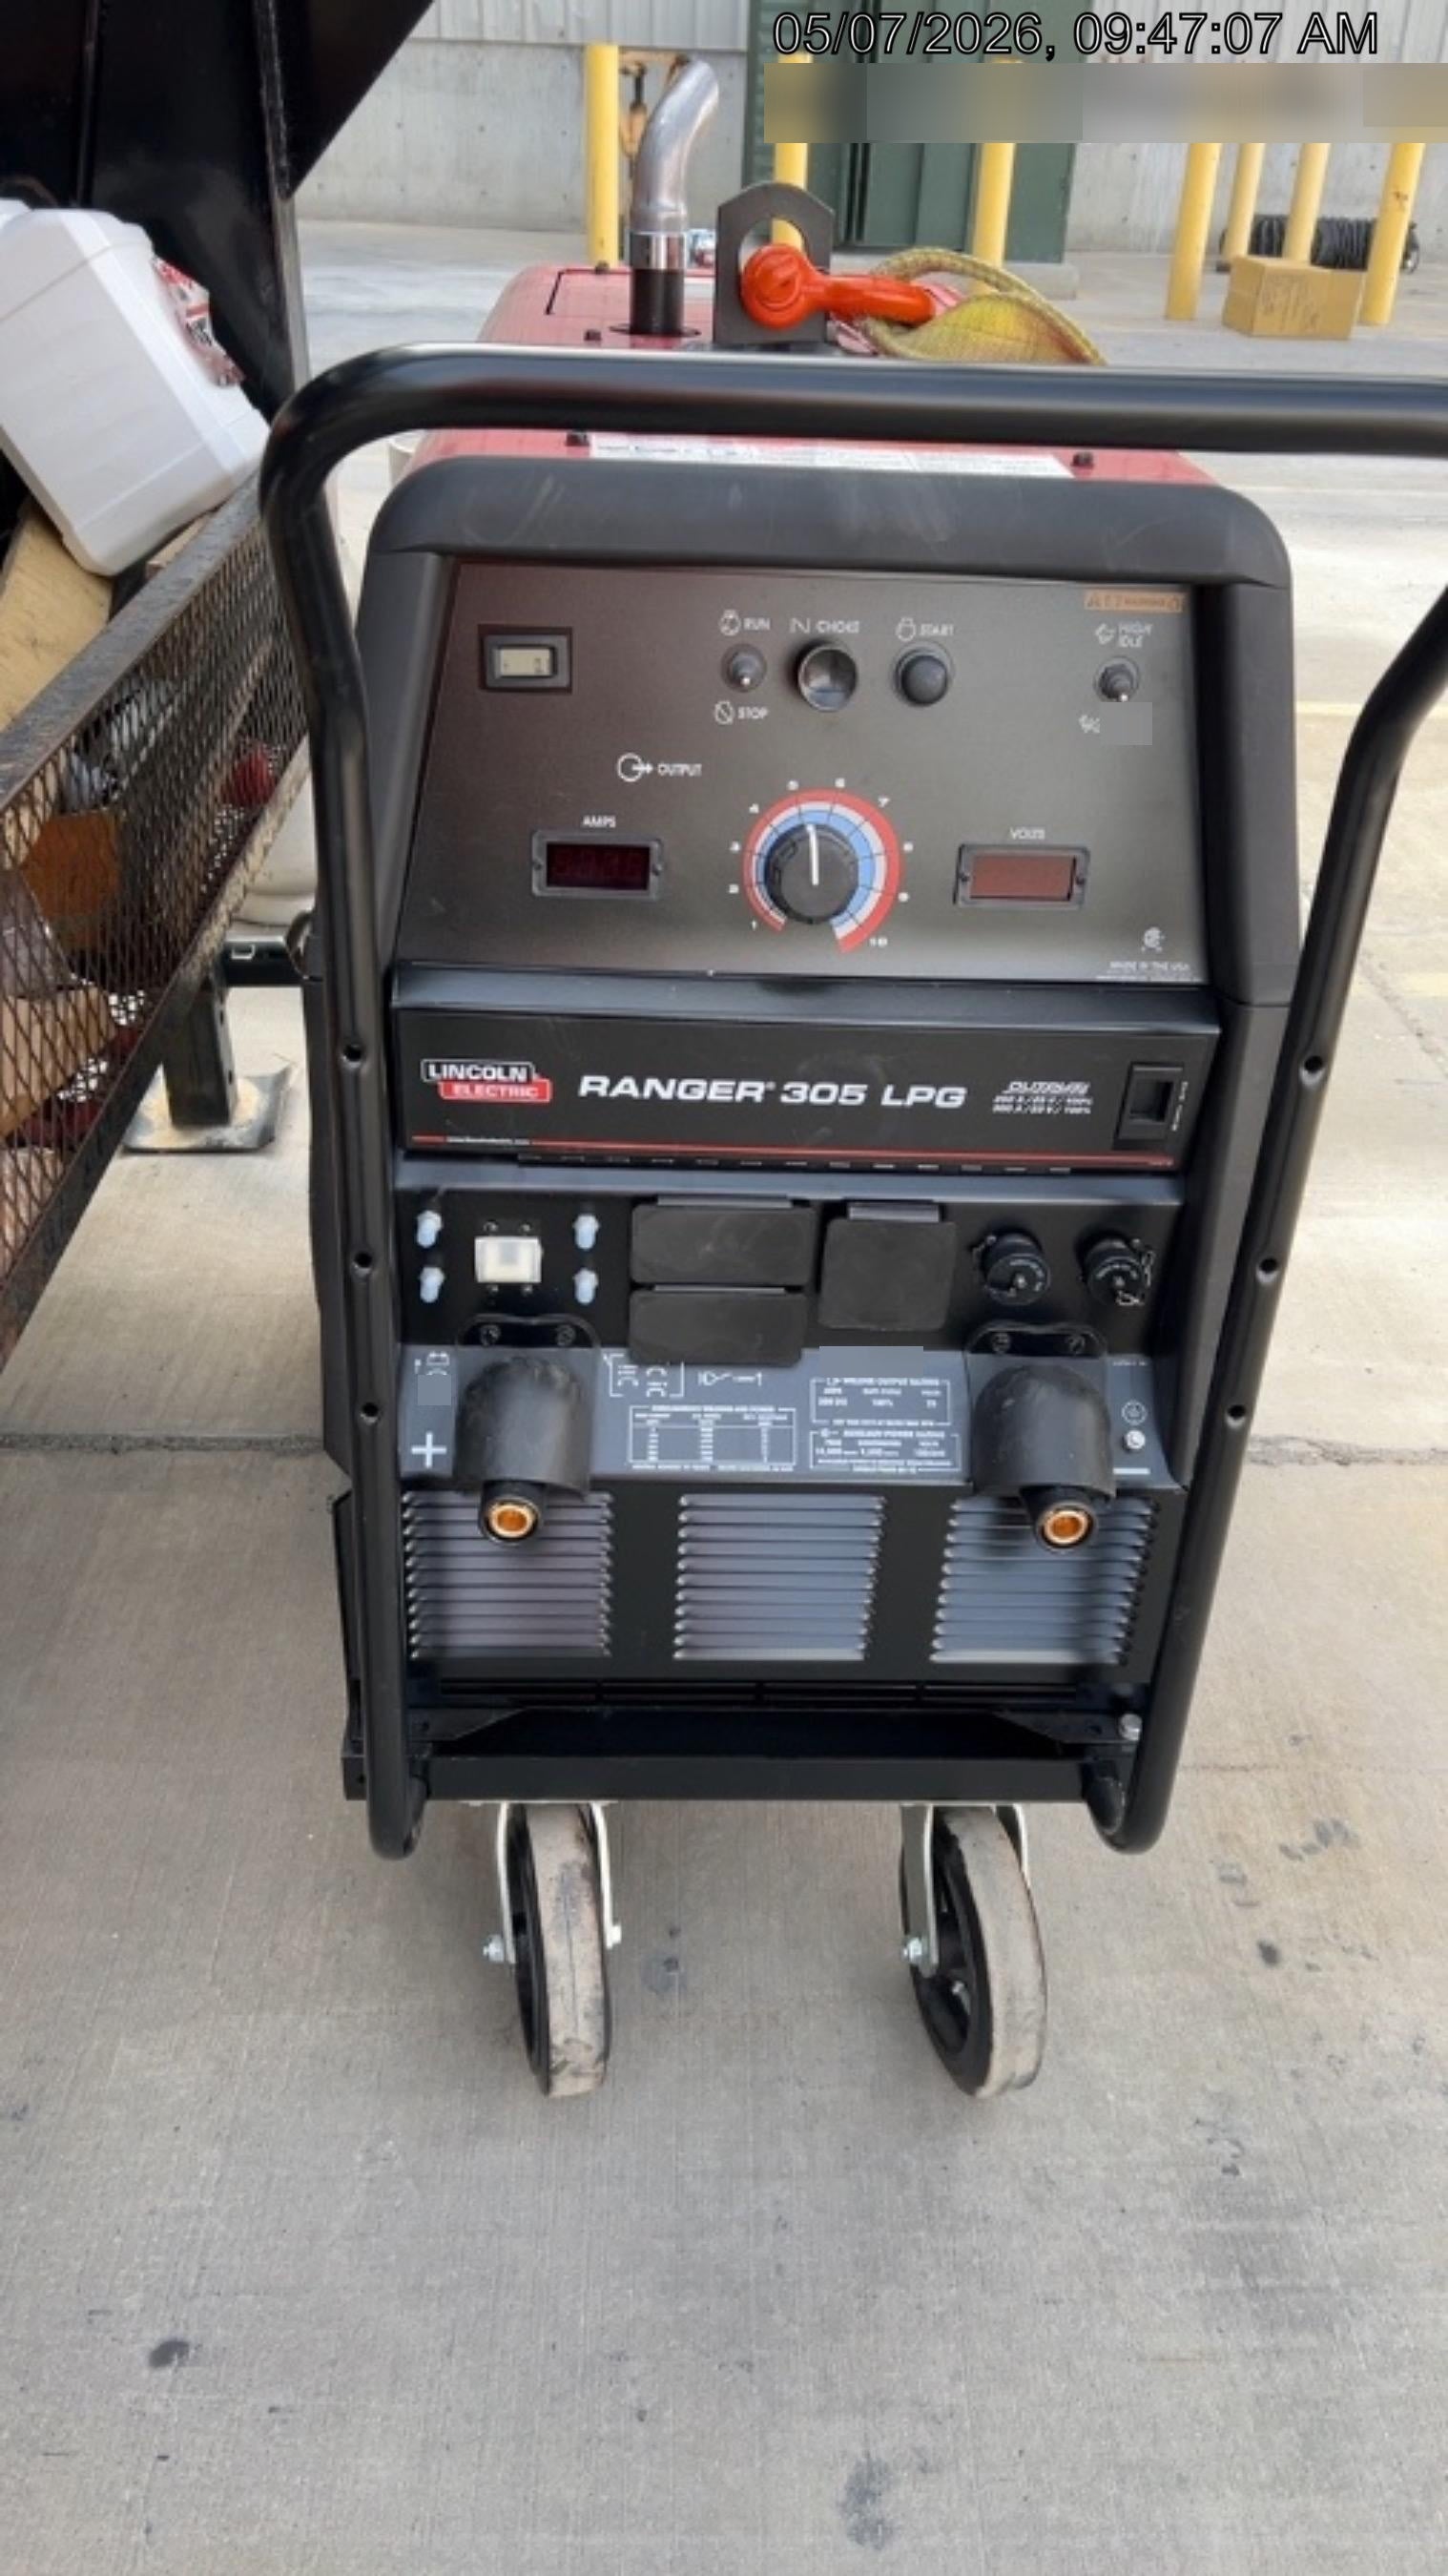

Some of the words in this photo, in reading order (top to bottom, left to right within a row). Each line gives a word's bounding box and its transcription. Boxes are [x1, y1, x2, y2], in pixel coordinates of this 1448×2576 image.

[743, 617, 771, 631] RUN
[920, 623, 954, 635] START
[737, 707, 769, 719] STOP
[657, 763, 703, 777] OUTPUT
[582, 815, 616, 828] AMPS
[1009, 826, 1045, 840] VOLTS
[428, 1063, 527, 1082] LINCOLN
[451, 1084, 539, 1098] ELECTRIC
[780, 1081, 868, 1106] 305
[880, 1085, 967, 1109] LPG
